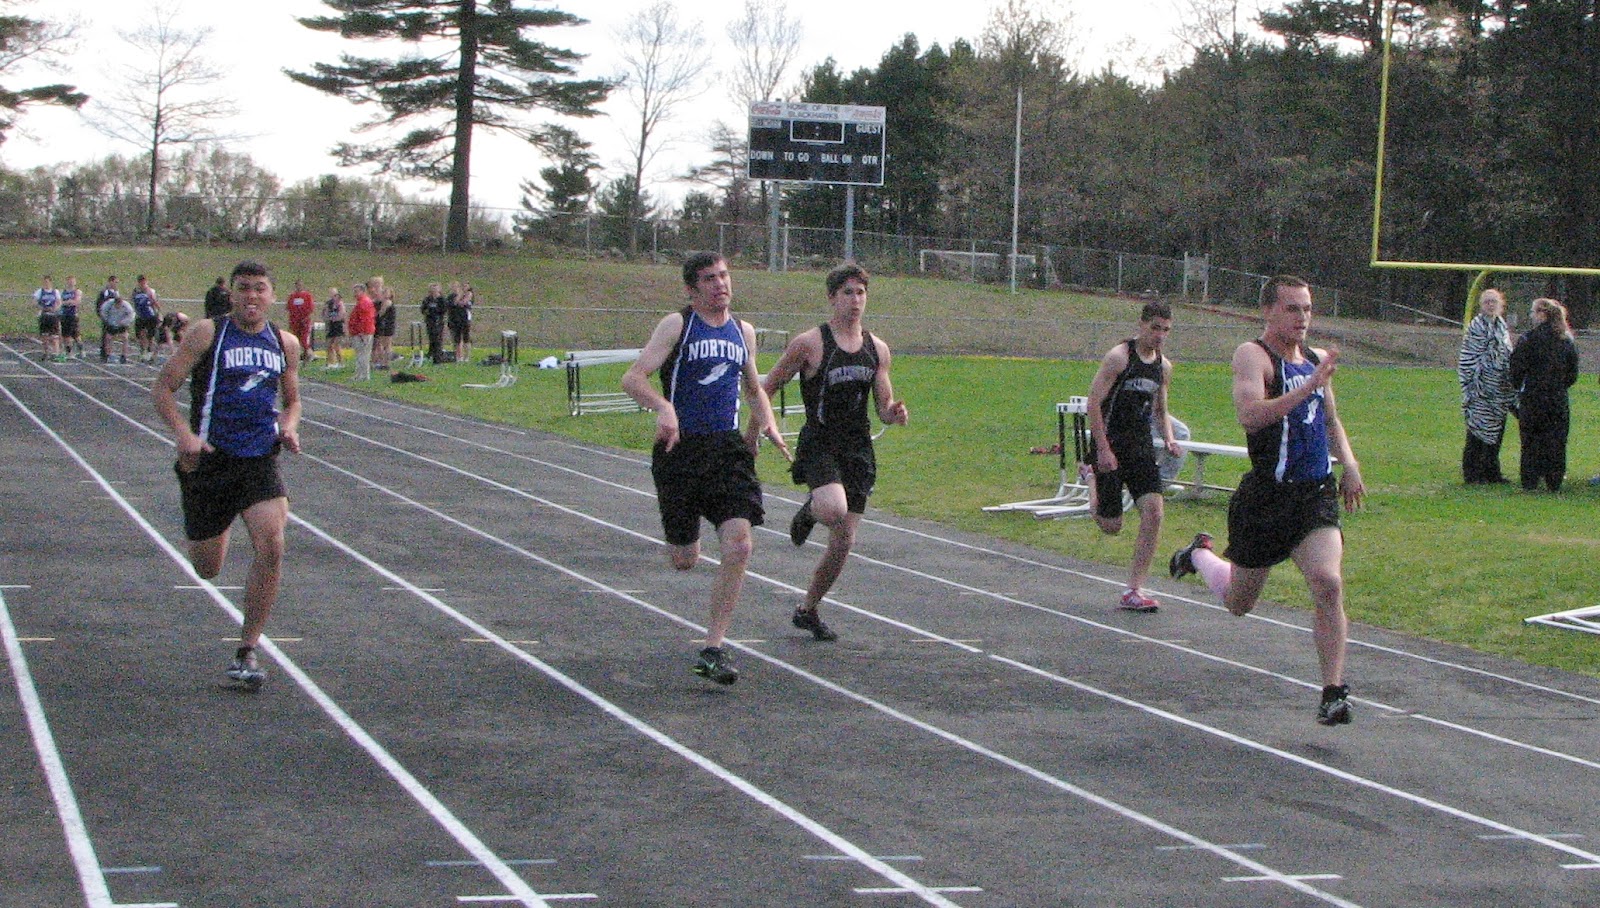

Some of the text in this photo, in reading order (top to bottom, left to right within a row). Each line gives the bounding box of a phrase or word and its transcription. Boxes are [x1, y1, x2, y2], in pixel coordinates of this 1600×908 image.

[856, 125, 881, 134] GUEST
[751, 151, 774, 160] DOWN
[784, 152, 810, 162] TO GO
[821, 153, 852, 163] BALL ON
[688, 339, 744, 366] NORTON
[224, 346, 281, 374] NORTON
